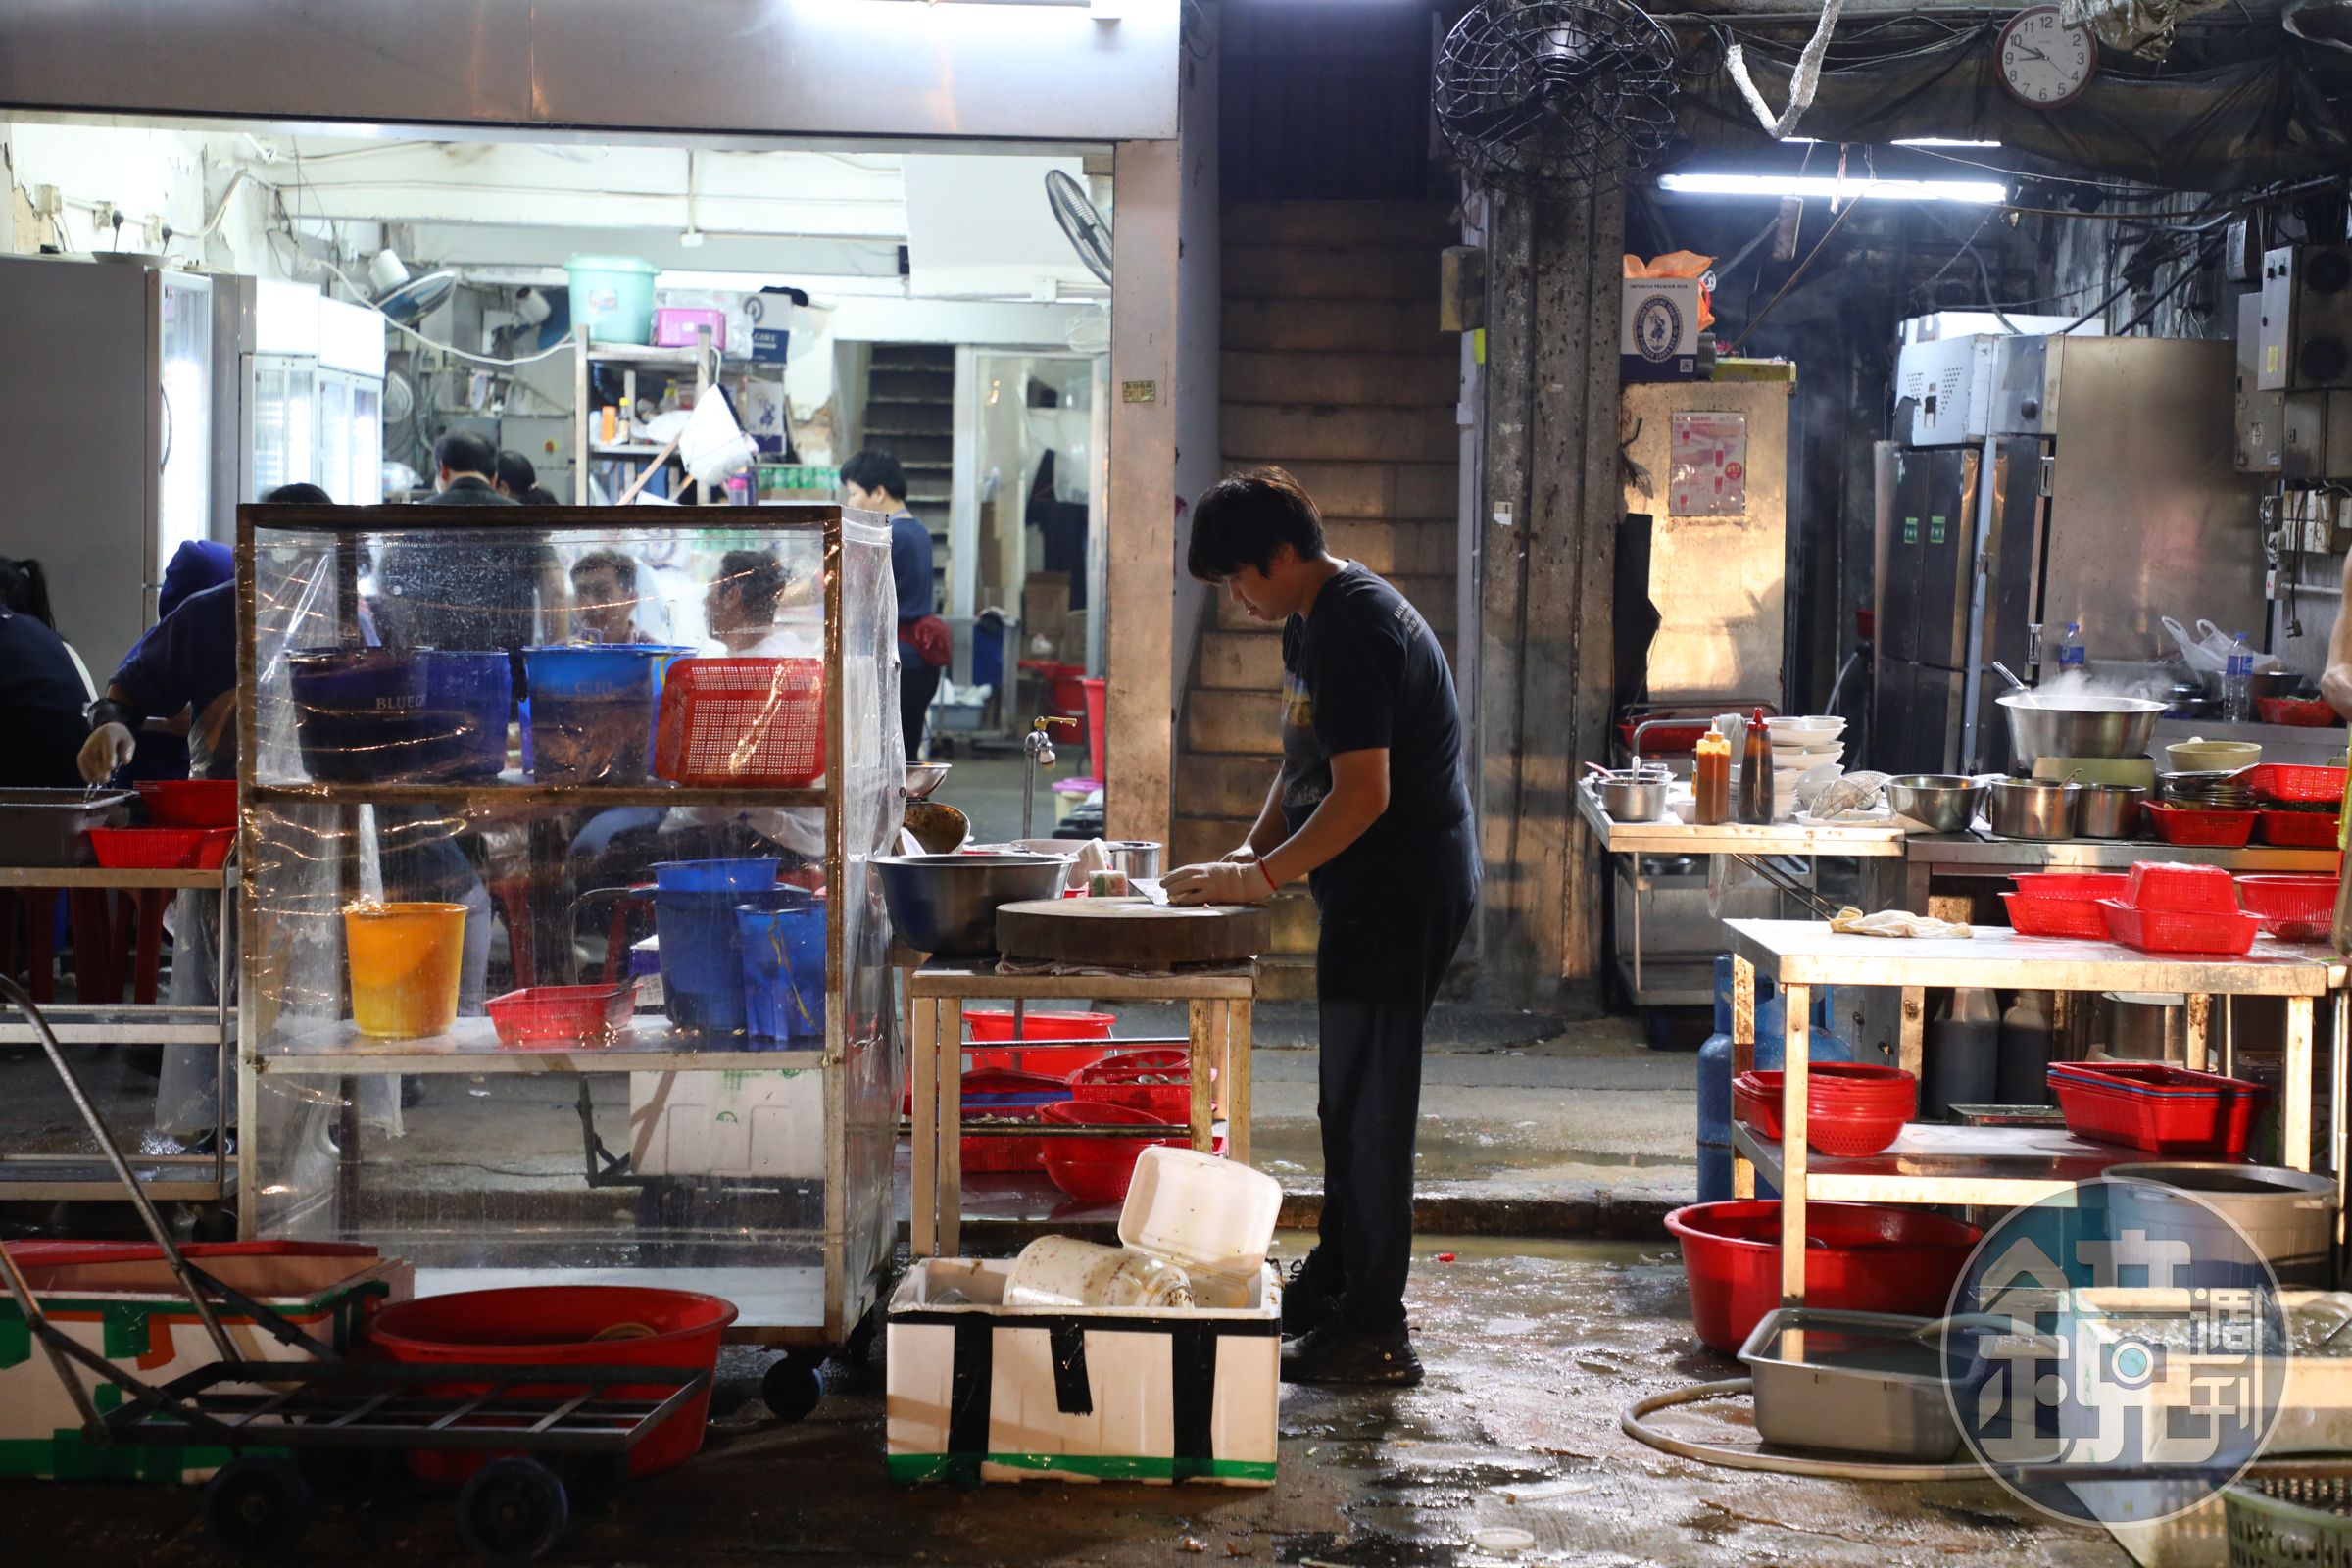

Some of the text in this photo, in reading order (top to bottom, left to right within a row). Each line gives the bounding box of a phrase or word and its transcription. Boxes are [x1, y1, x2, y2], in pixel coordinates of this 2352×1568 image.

[2024, 22, 2034, 33] 11
[2040, 16, 2053, 28] 12
[2010, 34, 2022, 47] 10
[2072, 34, 2081, 46] 2
[2005, 52, 2013, 65] 9
[2077, 52, 2084, 65] 3
[2009, 71, 2017, 82] 8
[2071, 71, 2079, 82] 4
[2022, 83, 2031, 95] 7
[2038, 87, 2047, 101] 6
[2057, 83, 2066, 95] 5
